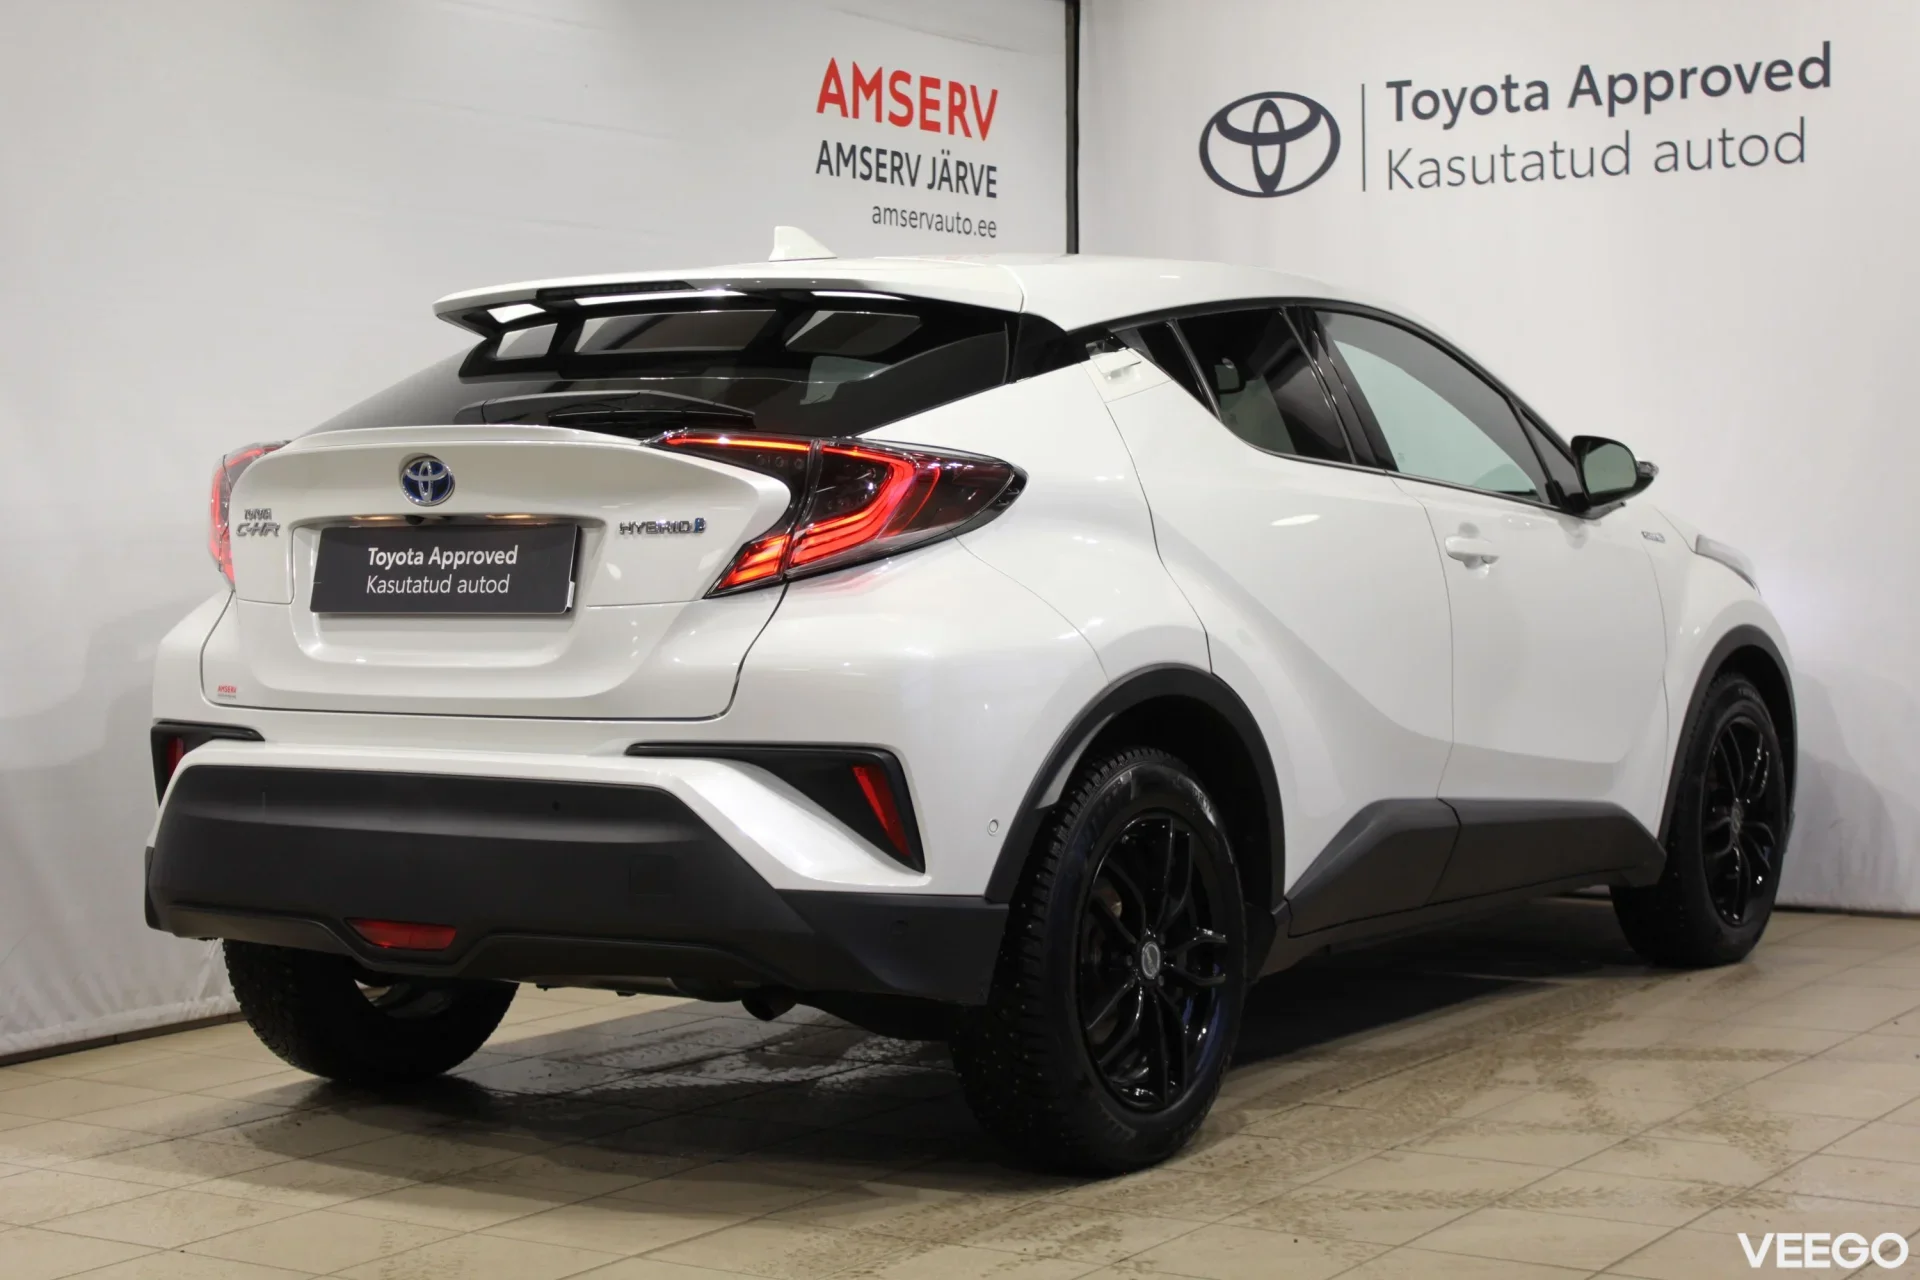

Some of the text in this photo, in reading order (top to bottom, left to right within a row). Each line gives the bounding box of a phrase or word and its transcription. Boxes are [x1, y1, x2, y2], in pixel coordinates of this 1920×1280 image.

[816, 57, 998, 141] AMSERV
[1387, 41, 1831, 130] Toyota Approved
[816, 140, 998, 199] AMSERV JÄRVE
[1388, 117, 1807, 190] Kasutatud autod
[872, 205, 997, 238] amservauto.ee
[619, 520, 692, 535] HYBRID
[367, 545, 518, 570] Toyota Approved
[366, 574, 510, 595] Kasutatud autod
